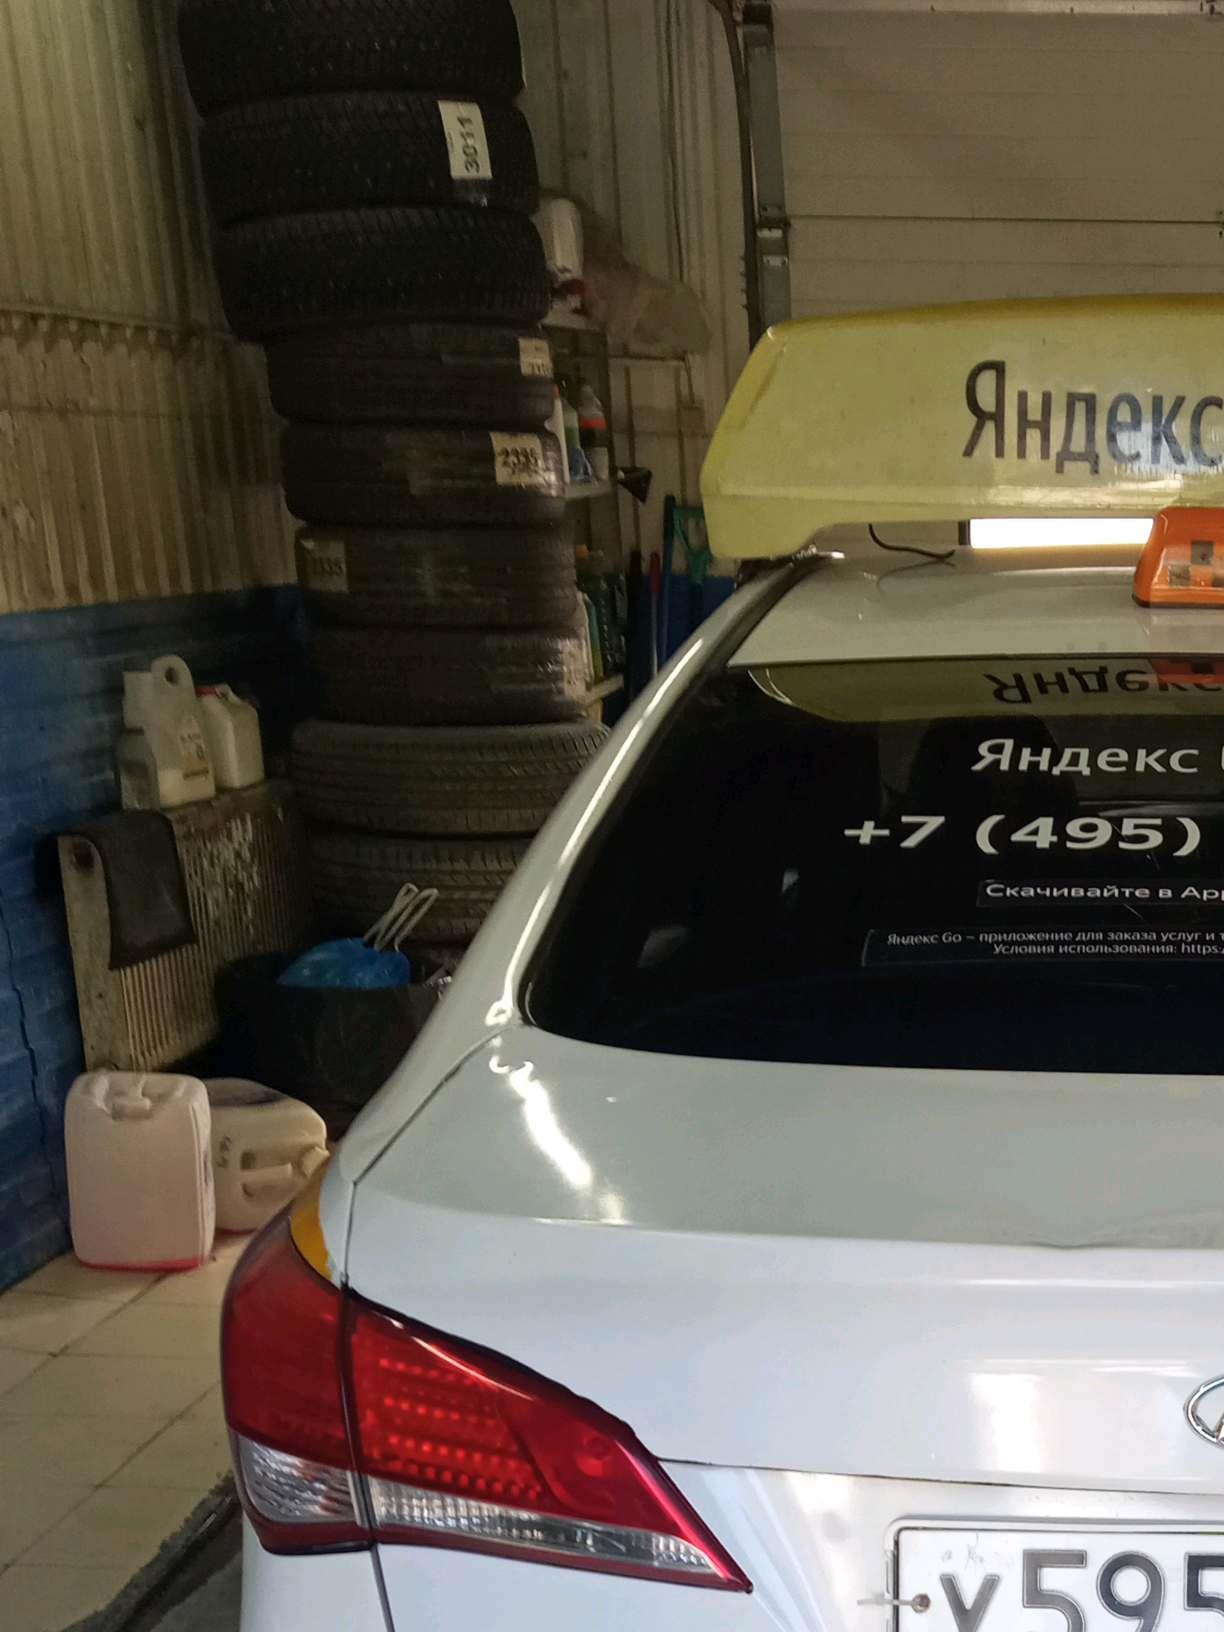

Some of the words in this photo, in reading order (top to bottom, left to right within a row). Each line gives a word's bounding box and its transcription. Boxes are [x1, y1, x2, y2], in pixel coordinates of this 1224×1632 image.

[457, 116, 481, 174] 3011
[962, 360, 1224, 474] Яндекс
[971, 738, 1199, 776] Яндекс
[844, 815, 945, 849] +7
[975, 814, 1201, 857] (495)
[986, 883, 1150, 899] Скачивайте
[1158, 887, 1173, 899] в
[887, 932, 938, 945] Яндекс
[942, 932, 962, 944] Go
[979, 931, 1073, 944] приложение
[1075, 931, 1103, 943] для
[1107, 931, 1157, 942] заказа
[1160, 931, 1201, 943] услуг
[1206, 932, 1216, 942] и
[993, 943, 1055, 955] Условия
[1059, 942, 1178, 955] использования:
